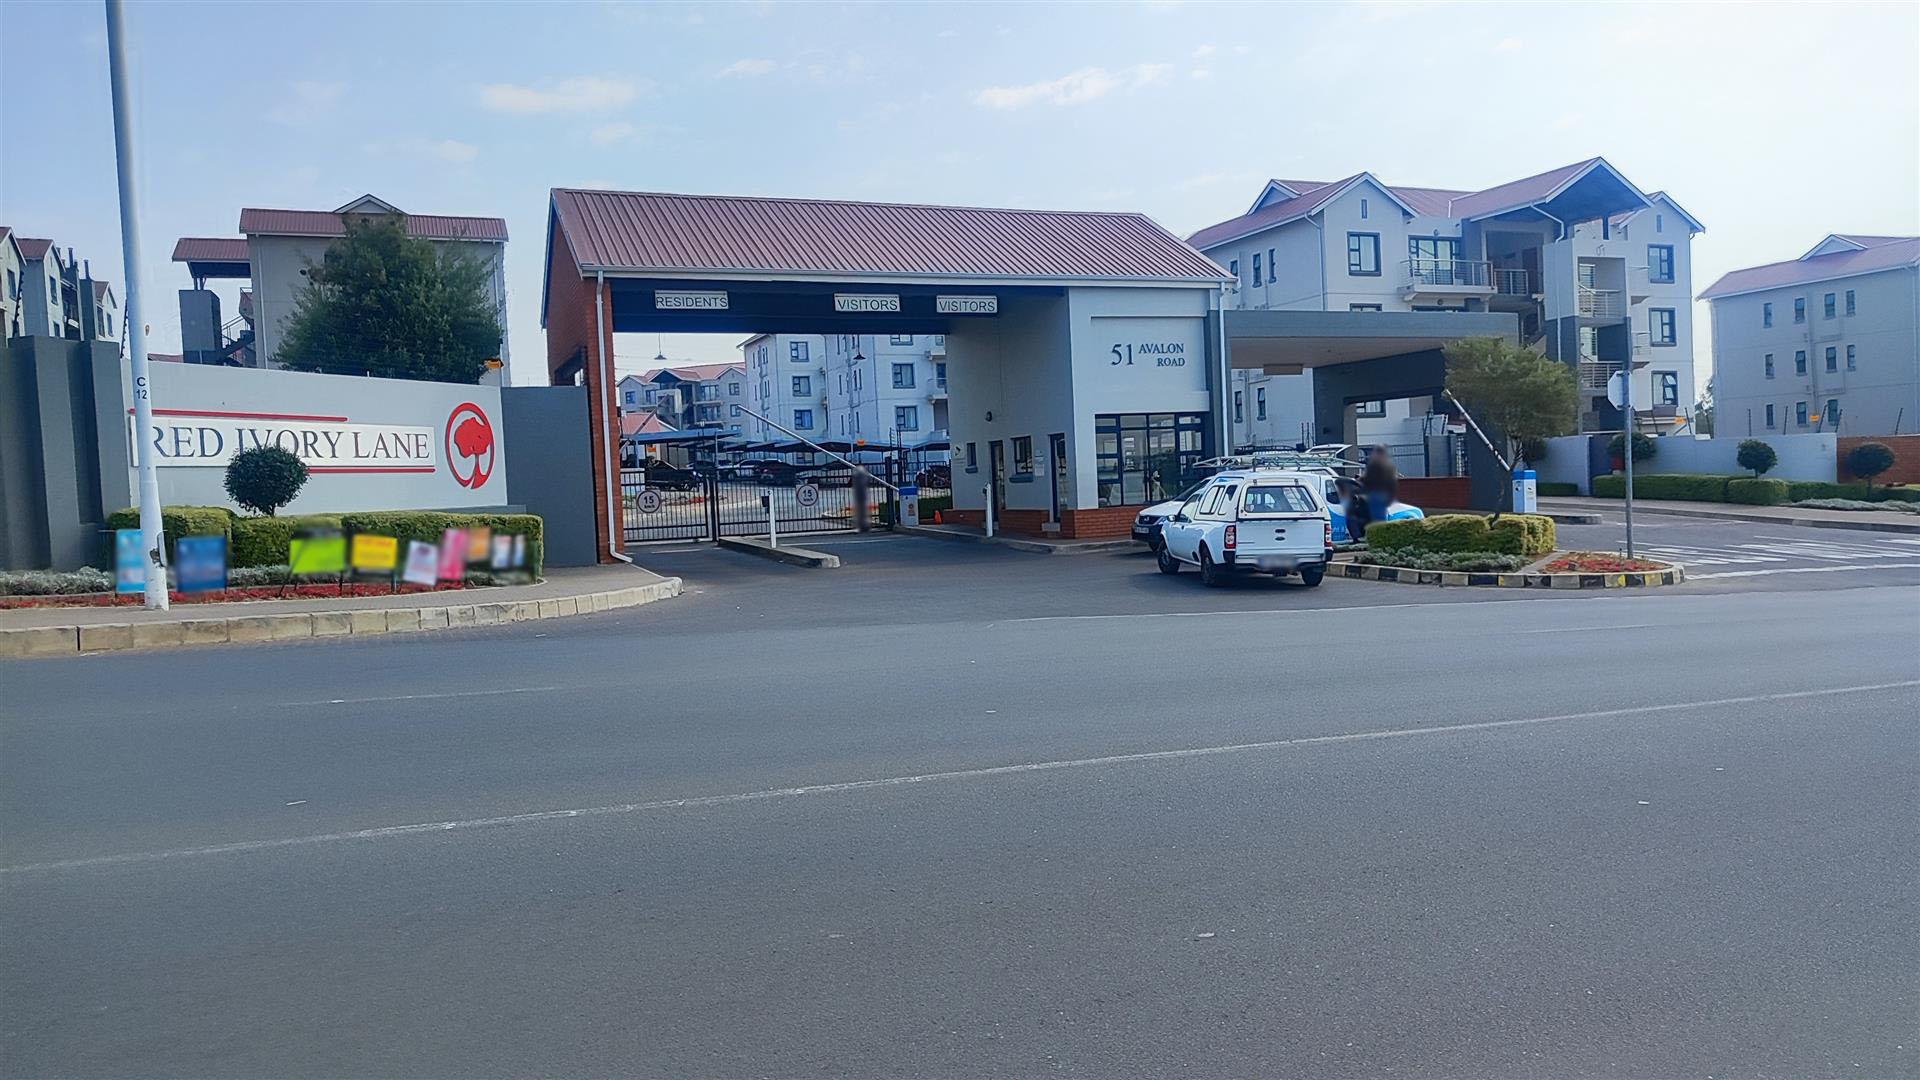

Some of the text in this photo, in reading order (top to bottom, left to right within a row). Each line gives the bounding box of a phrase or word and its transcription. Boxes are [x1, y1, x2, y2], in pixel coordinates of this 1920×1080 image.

[656, 296, 728, 308] RESIDENTS
[837, 299, 898, 311] VISITORS
[938, 301, 996, 312] VISITORS
[1111, 343, 1185, 366] 51 AVALON
[1157, 357, 1186, 367] ROAD
[136, 376, 146, 387] C
[136, 389, 147, 400] 12
[235, 428, 344, 459] IVORY
[353, 431, 430, 459] LANE
[803, 489, 812, 498] 15
[644, 495, 655, 504] 15
